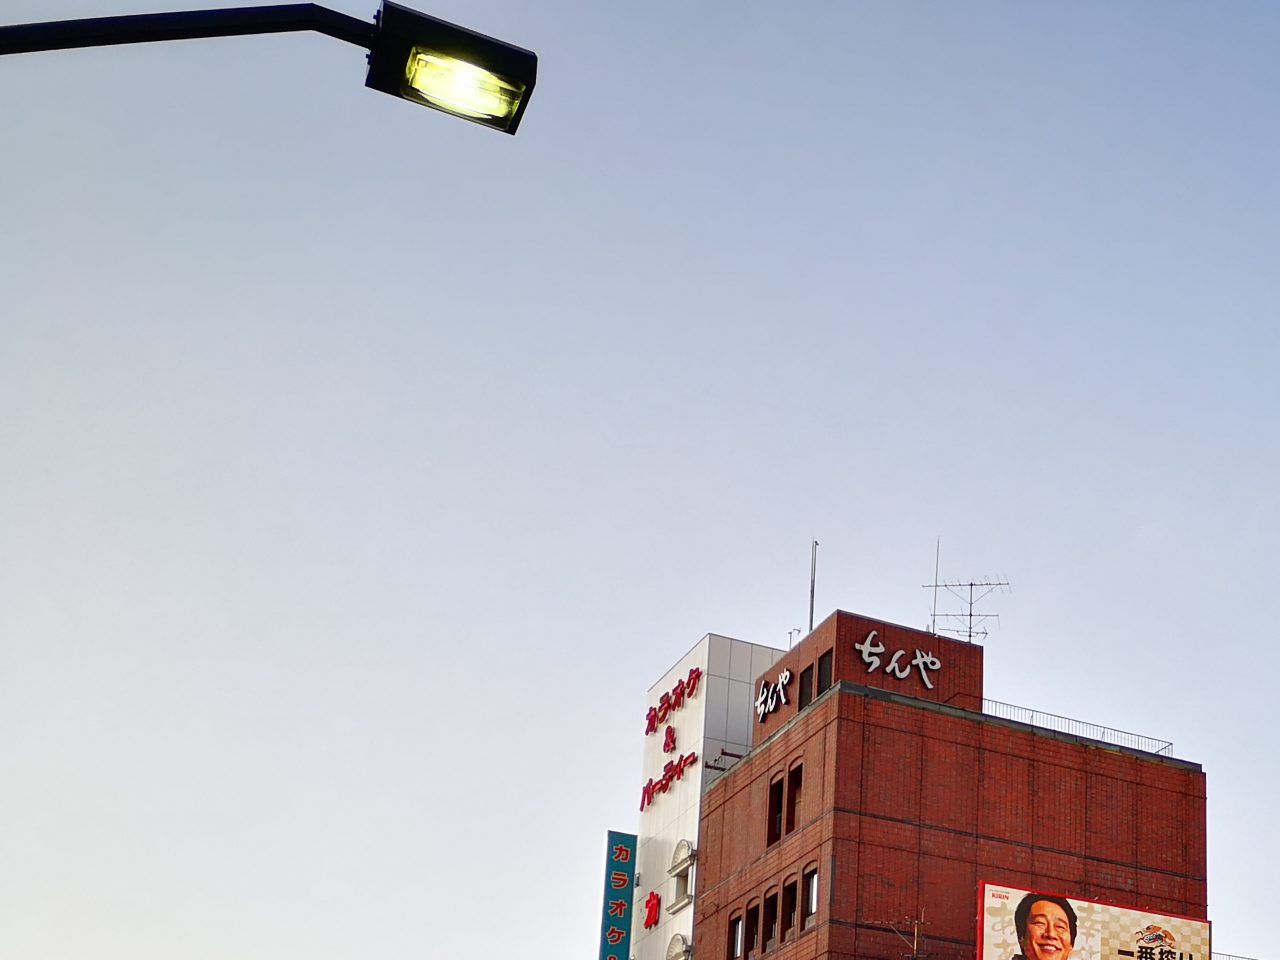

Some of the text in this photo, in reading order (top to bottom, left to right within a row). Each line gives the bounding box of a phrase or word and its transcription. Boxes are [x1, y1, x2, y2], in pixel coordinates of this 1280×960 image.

[854, 630, 942, 690] ちんや
[645, 666, 702, 736] カラオケ
[754, 667, 792, 723] ちんや
[662, 725, 677, 754] &
[639, 751, 699, 812] パーティー
[991, 892, 1010, 901] KIRIN
